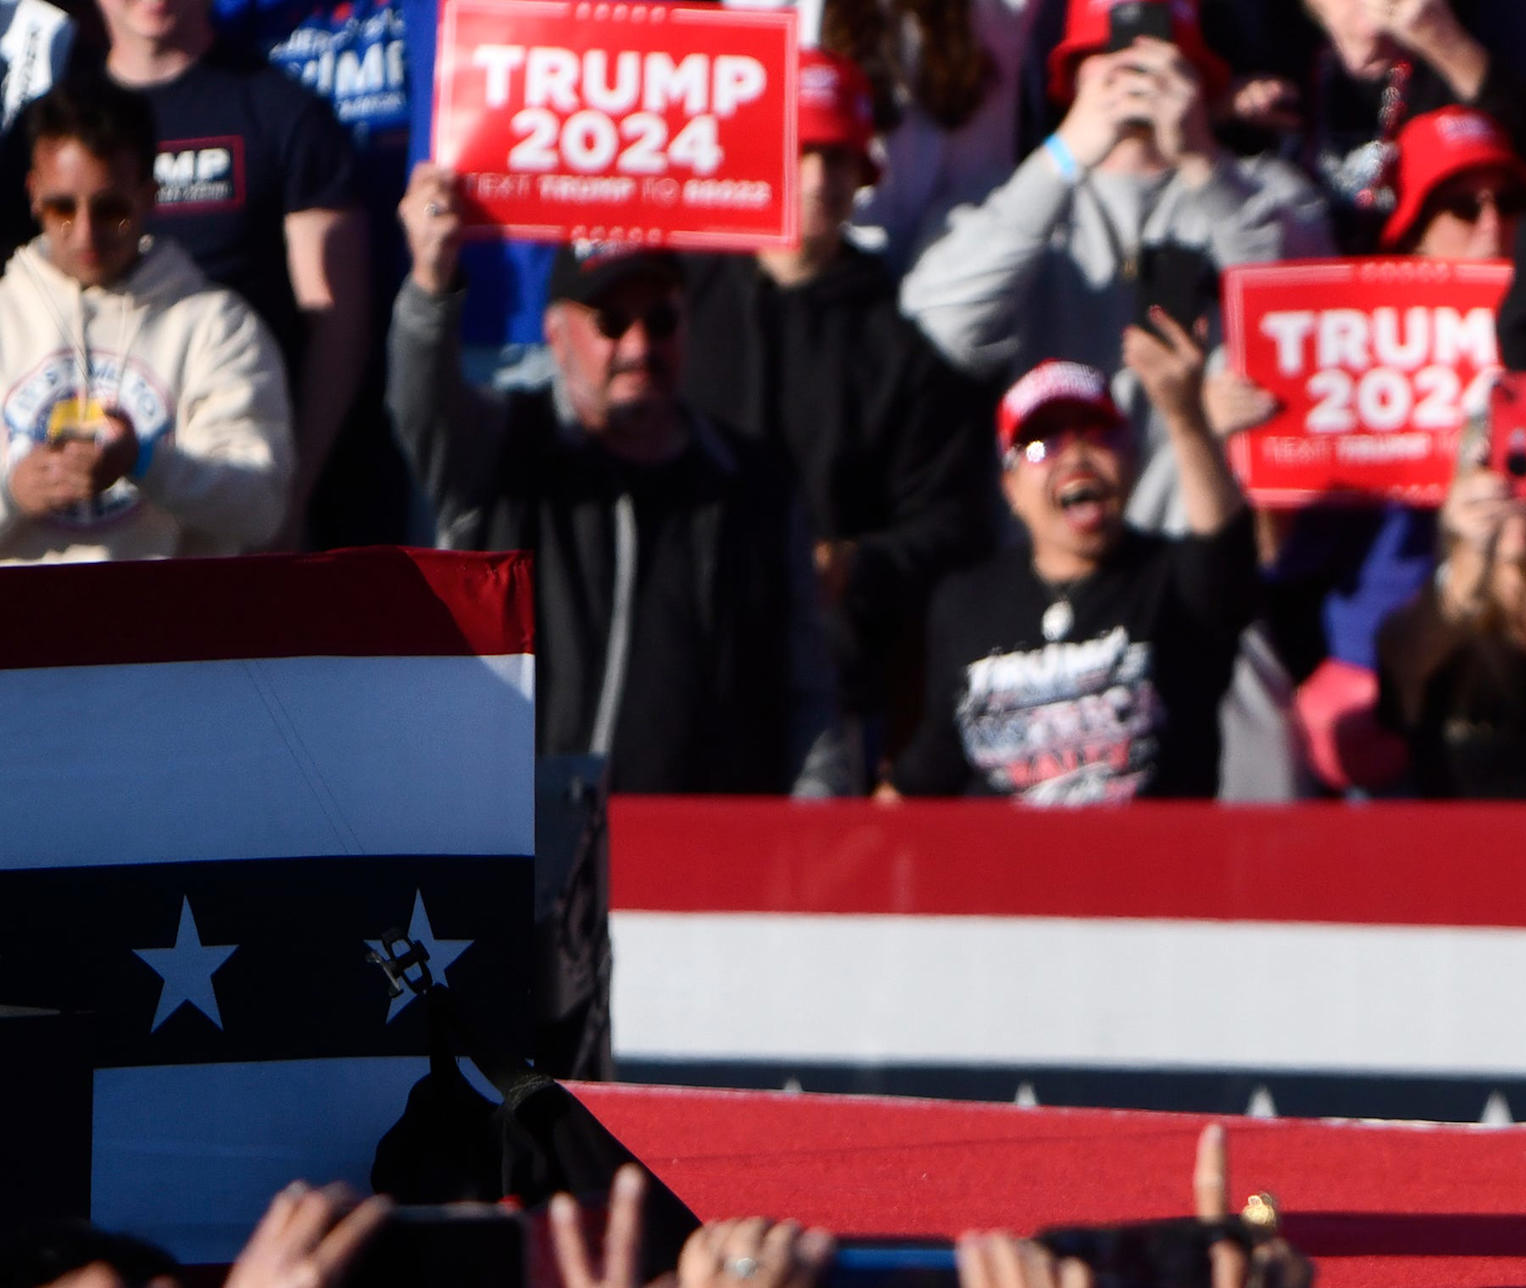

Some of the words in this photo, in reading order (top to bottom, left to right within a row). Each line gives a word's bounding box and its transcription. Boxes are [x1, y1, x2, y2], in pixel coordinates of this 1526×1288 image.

[474, 45, 767, 117] TRUMP
[508, 107, 723, 175] 2024
[540, 175, 637, 203] TRUMP
[1260, 308, 1497, 377] TRUM
